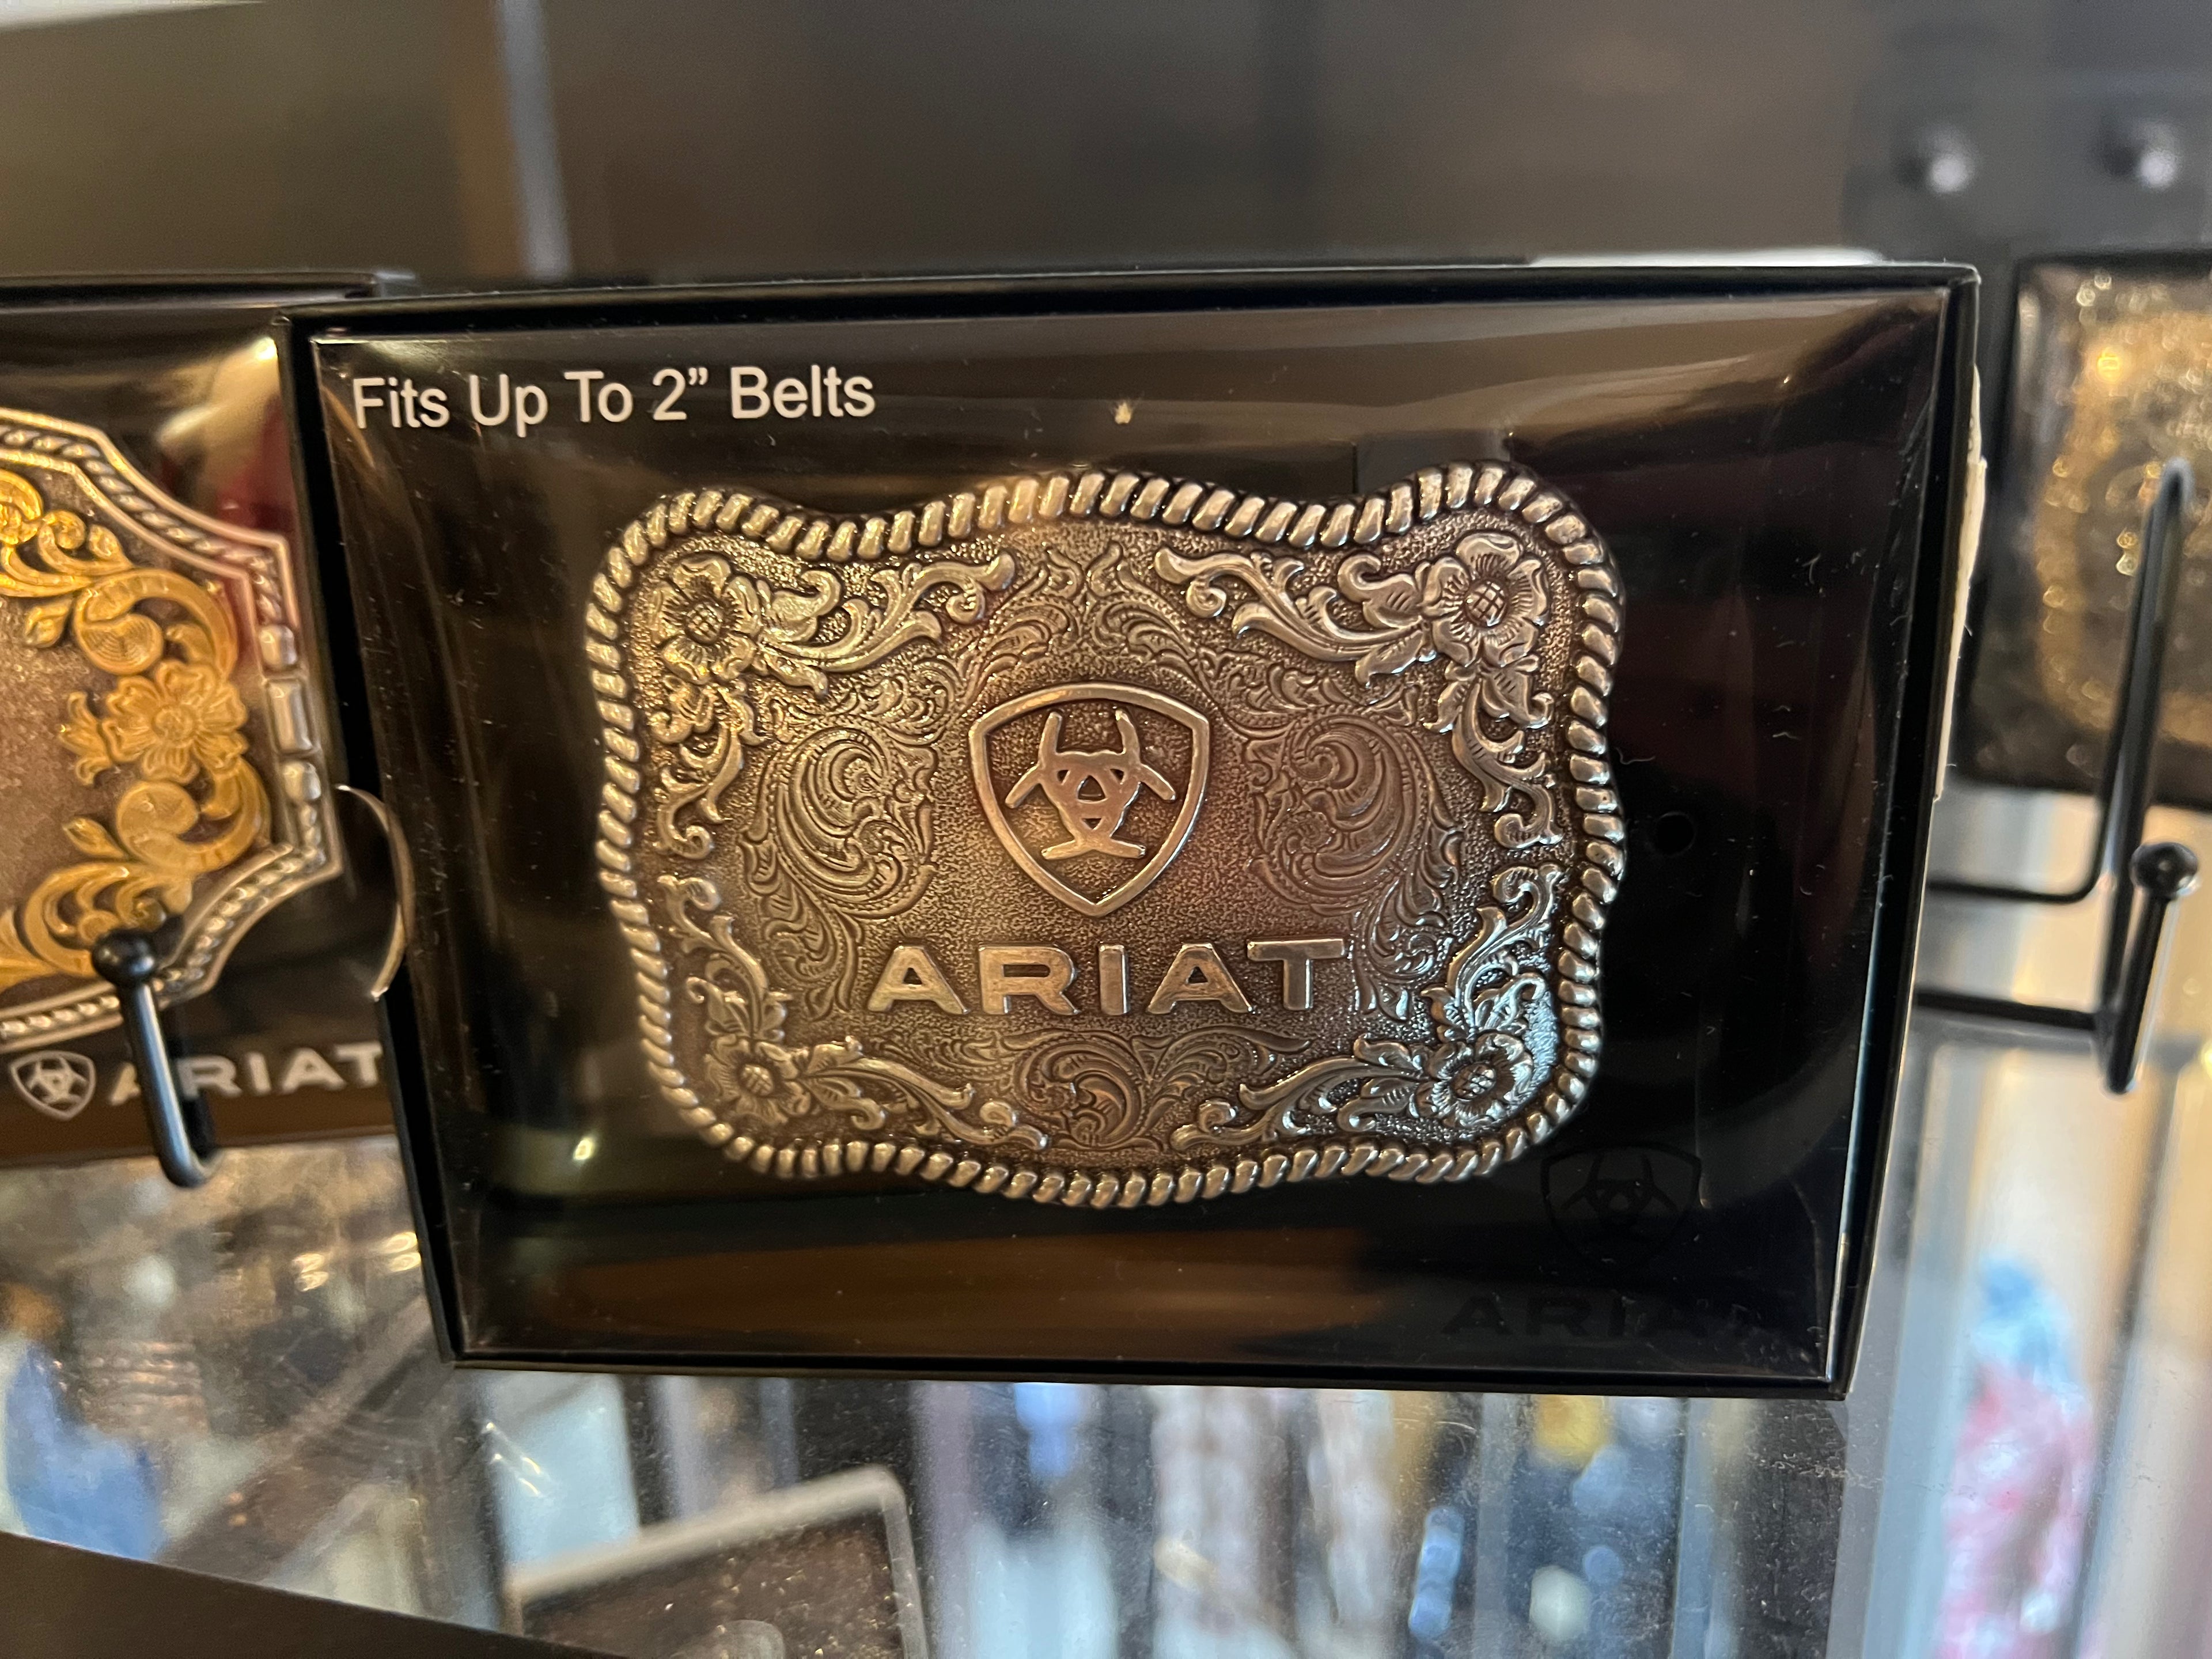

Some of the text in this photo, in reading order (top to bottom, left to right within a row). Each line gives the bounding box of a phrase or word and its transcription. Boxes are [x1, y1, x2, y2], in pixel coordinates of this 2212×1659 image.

[352, 378, 450, 429] Fits
[469, 373, 548, 438] Up
[565, 370, 634, 423] To
[730, 365, 876, 419] Belts
[867, 938, 1348, 1016] ARIAT
